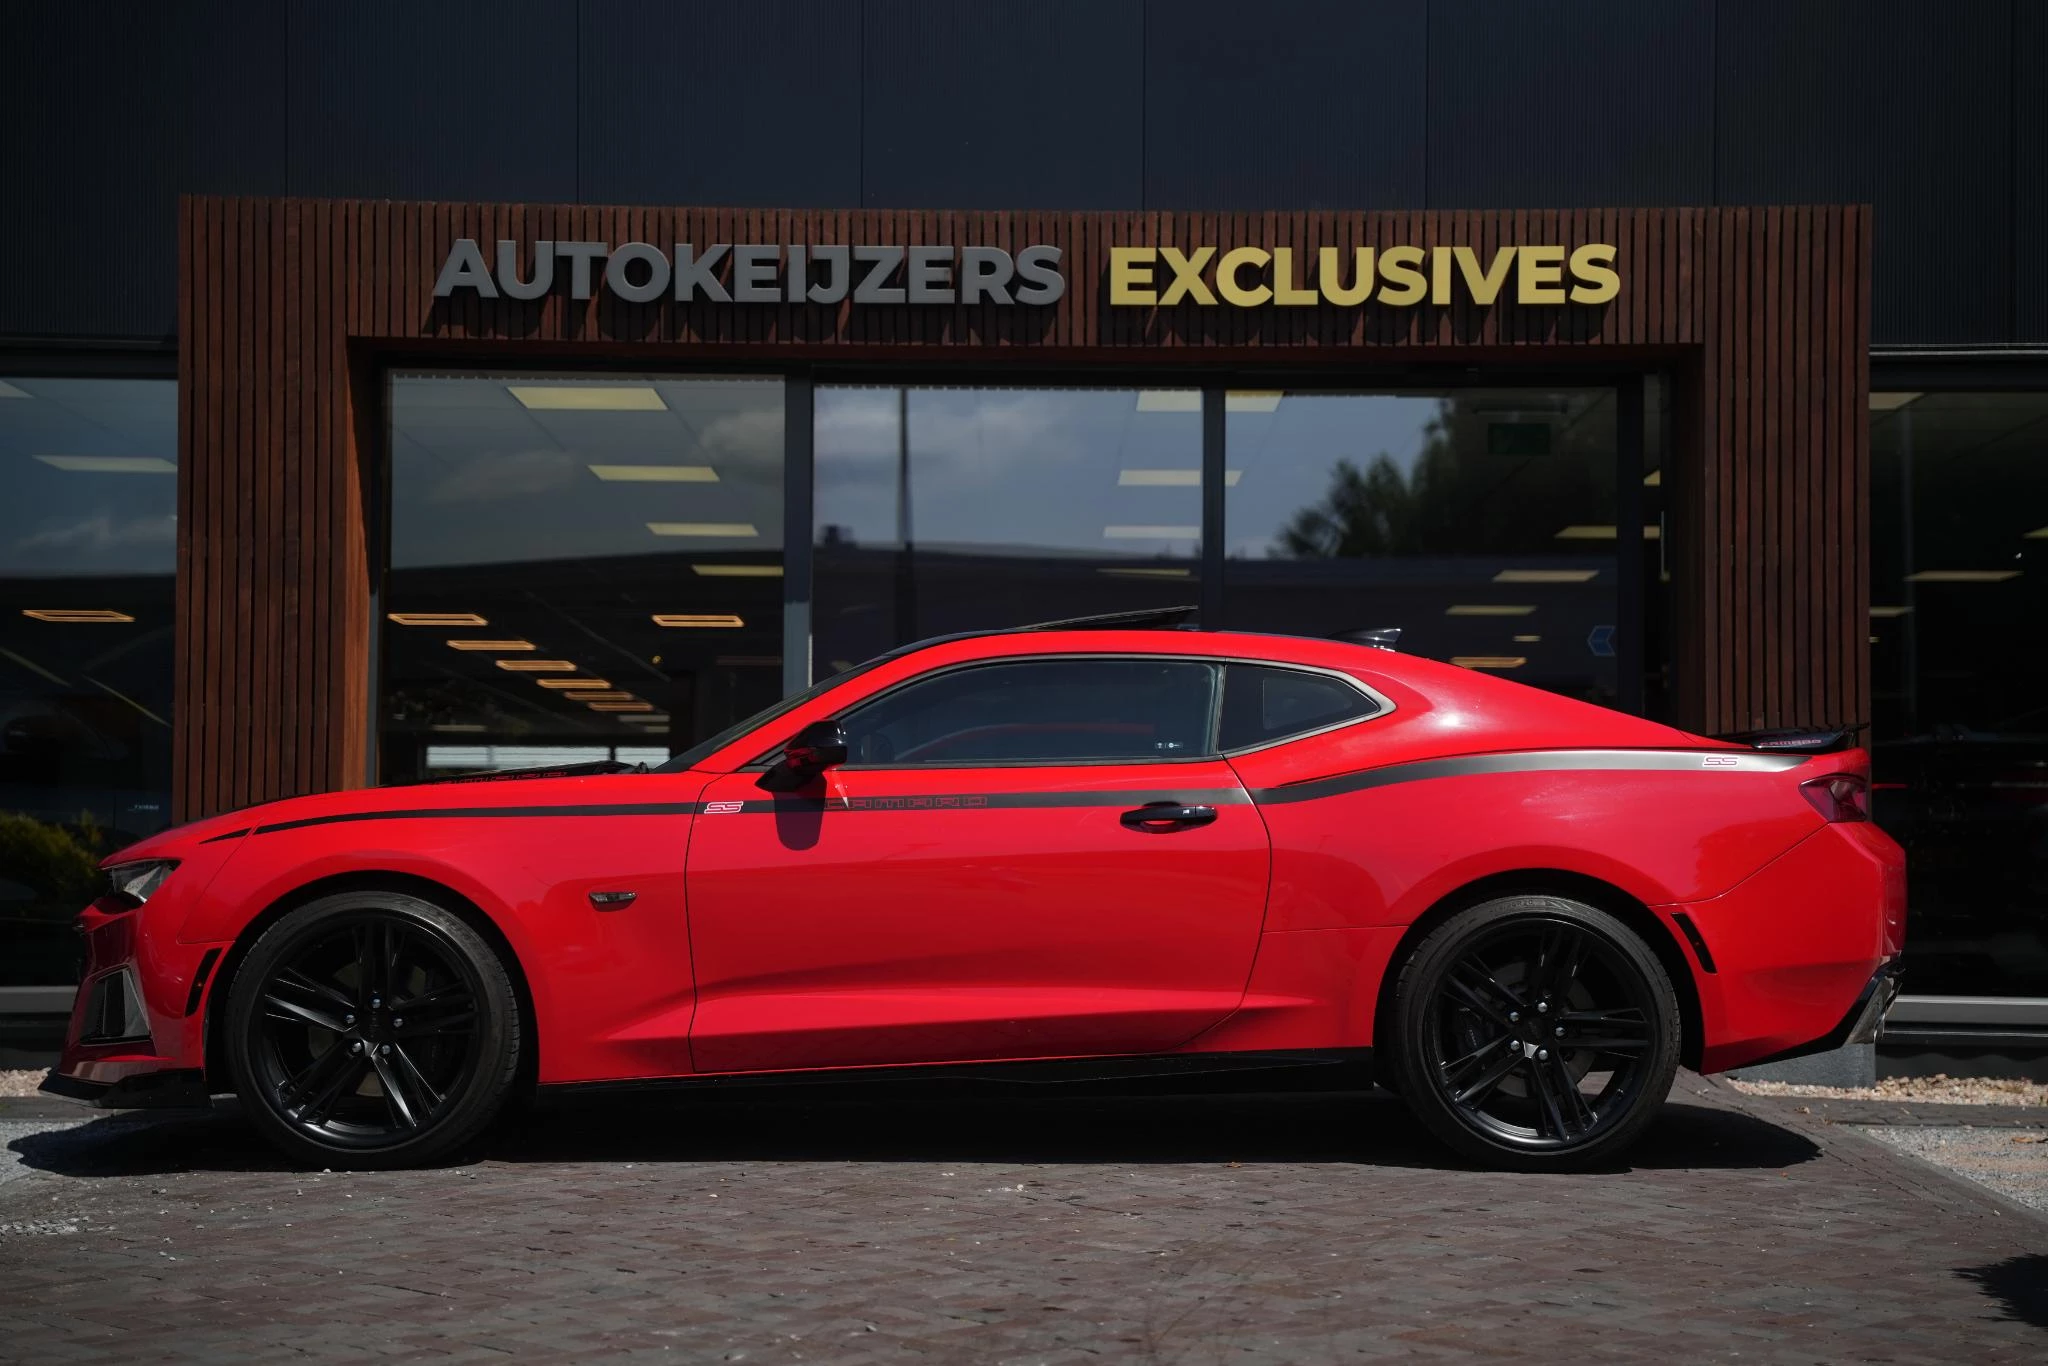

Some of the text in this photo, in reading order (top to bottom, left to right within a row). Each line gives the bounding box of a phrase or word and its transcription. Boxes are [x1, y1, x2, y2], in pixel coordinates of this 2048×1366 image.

[433, 238, 1621, 307] AUTOKEIJZERS EXCLUSIVES
[1702, 755, 1739, 767] SS
[703, 800, 744, 814] SS
